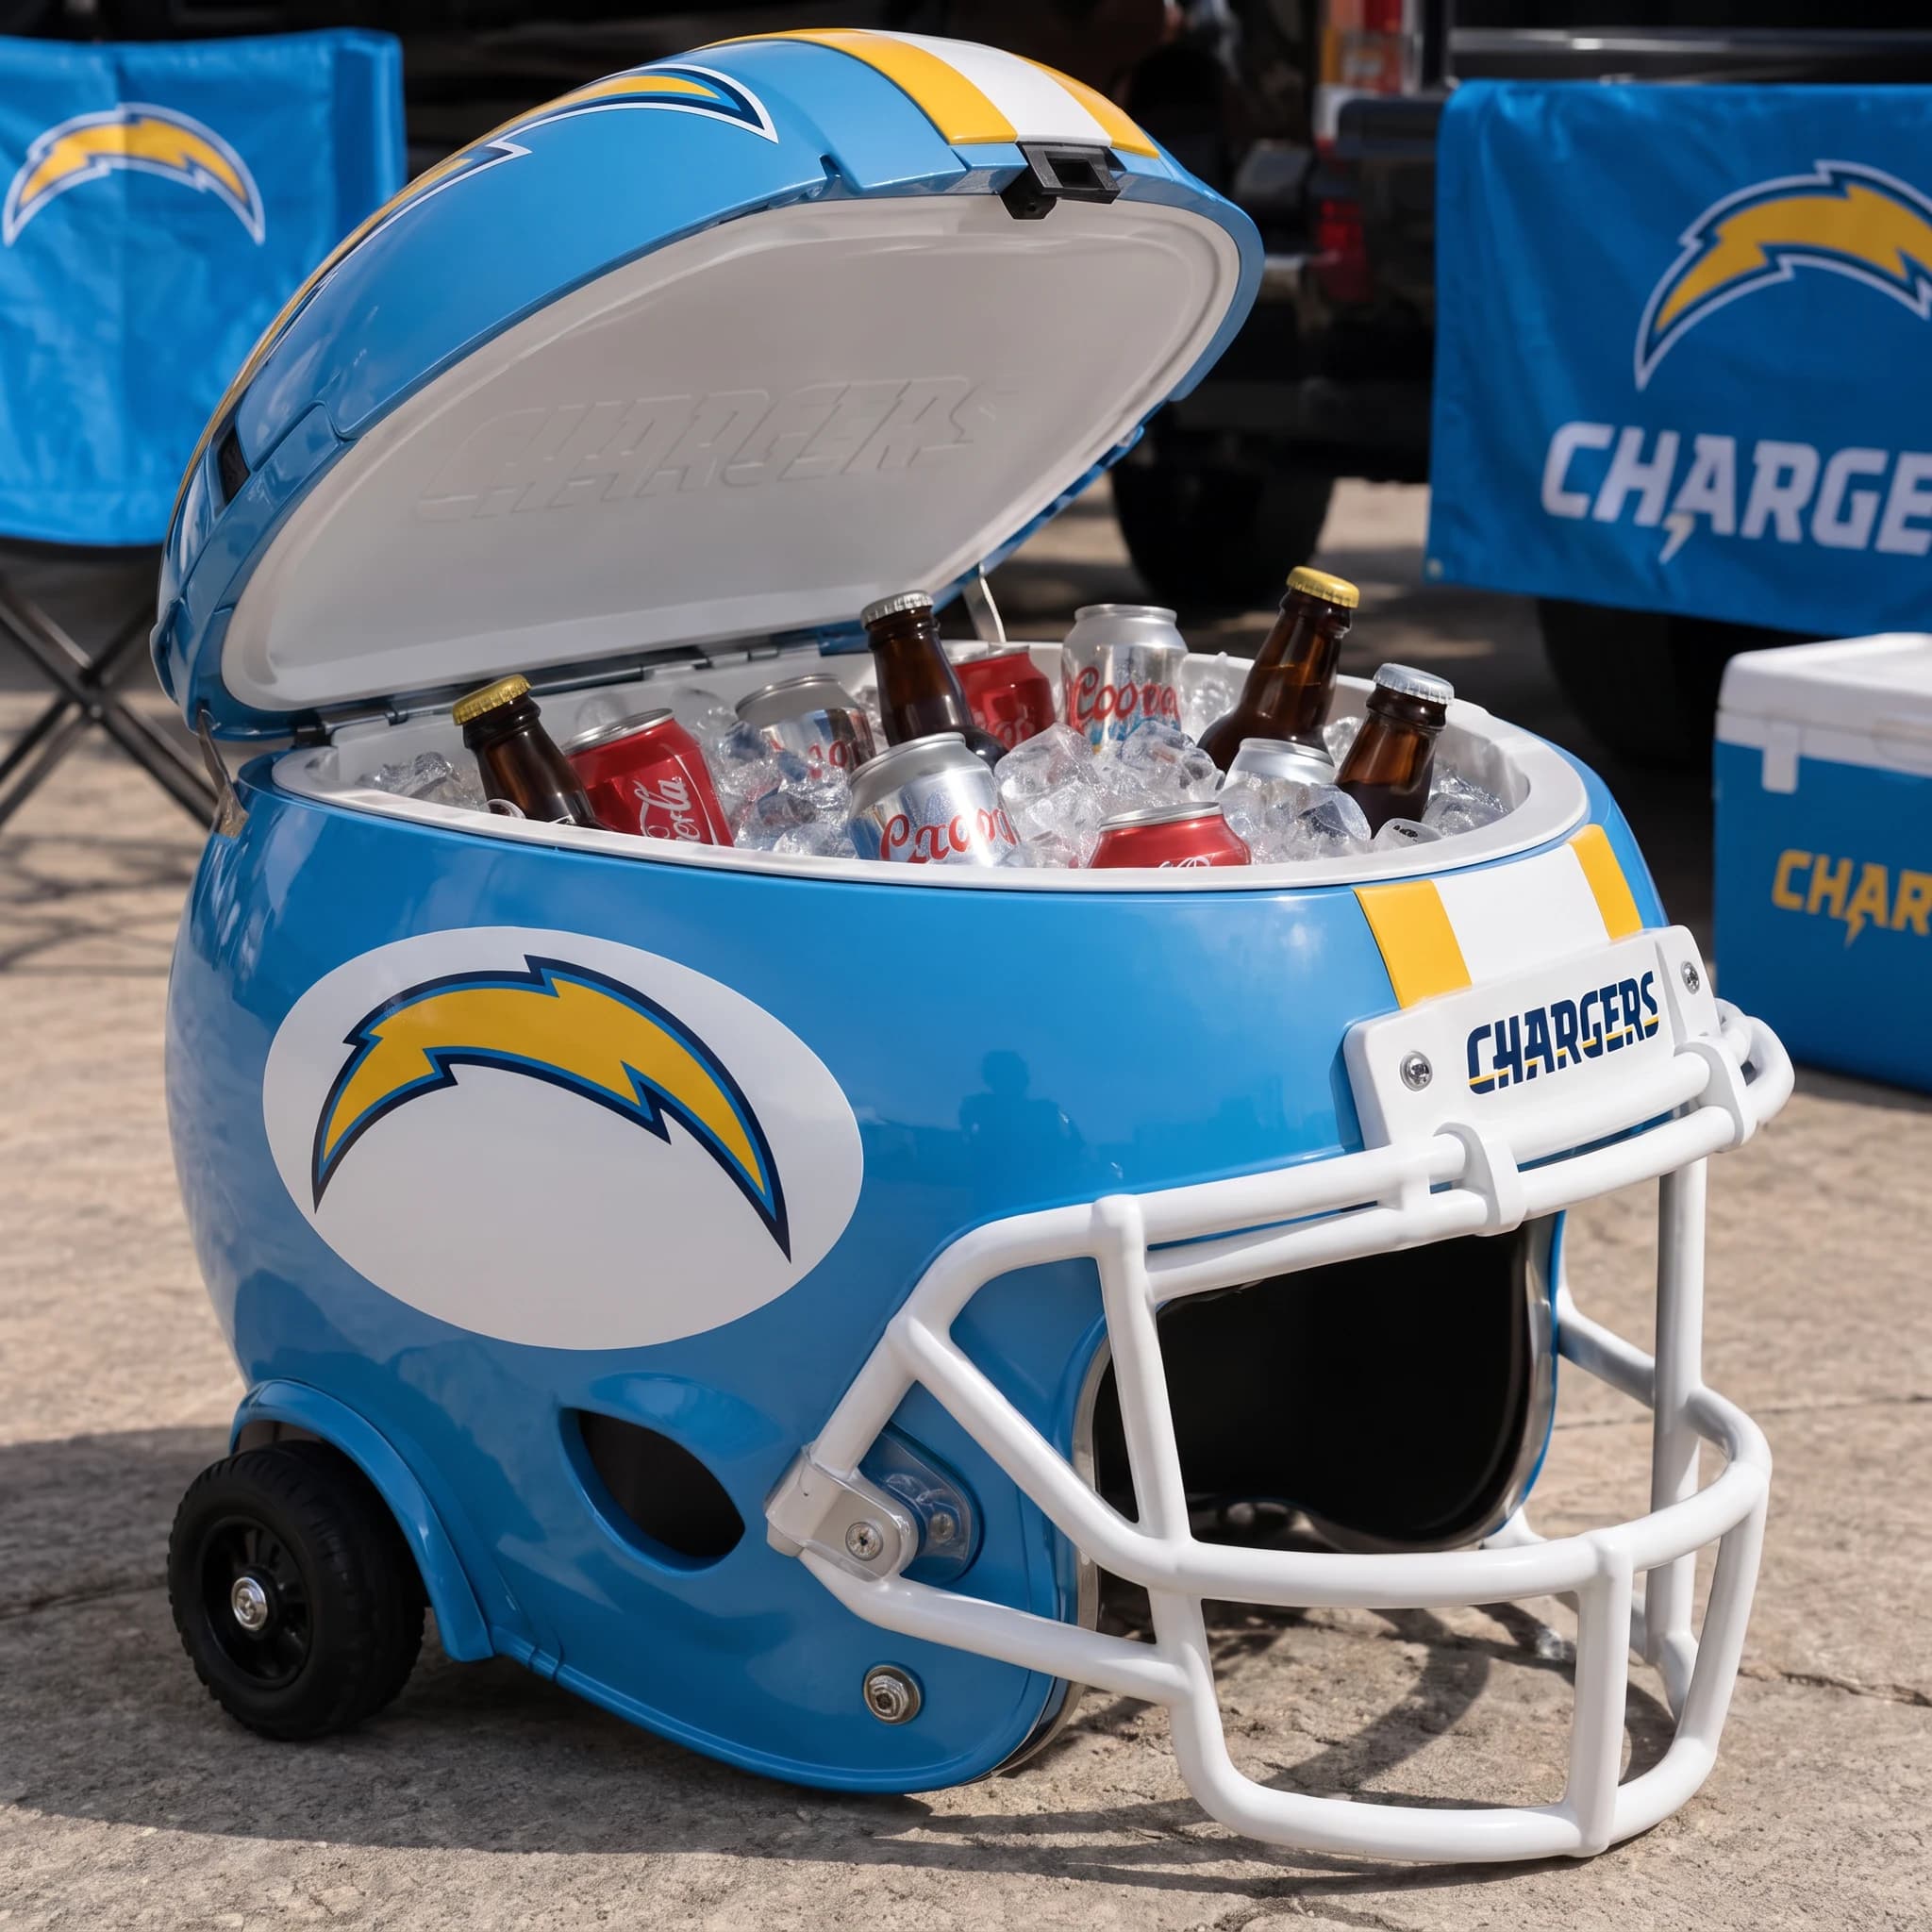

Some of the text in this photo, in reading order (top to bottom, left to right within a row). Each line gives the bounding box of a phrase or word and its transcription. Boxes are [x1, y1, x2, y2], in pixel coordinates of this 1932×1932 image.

[414, 375, 996, 524] CHARGERS
[1541, 421, 1932, 563] CHARGE
[1771, 848, 1932, 950] CHAR
[1466, 970, 1660, 1095] CHARGERS
